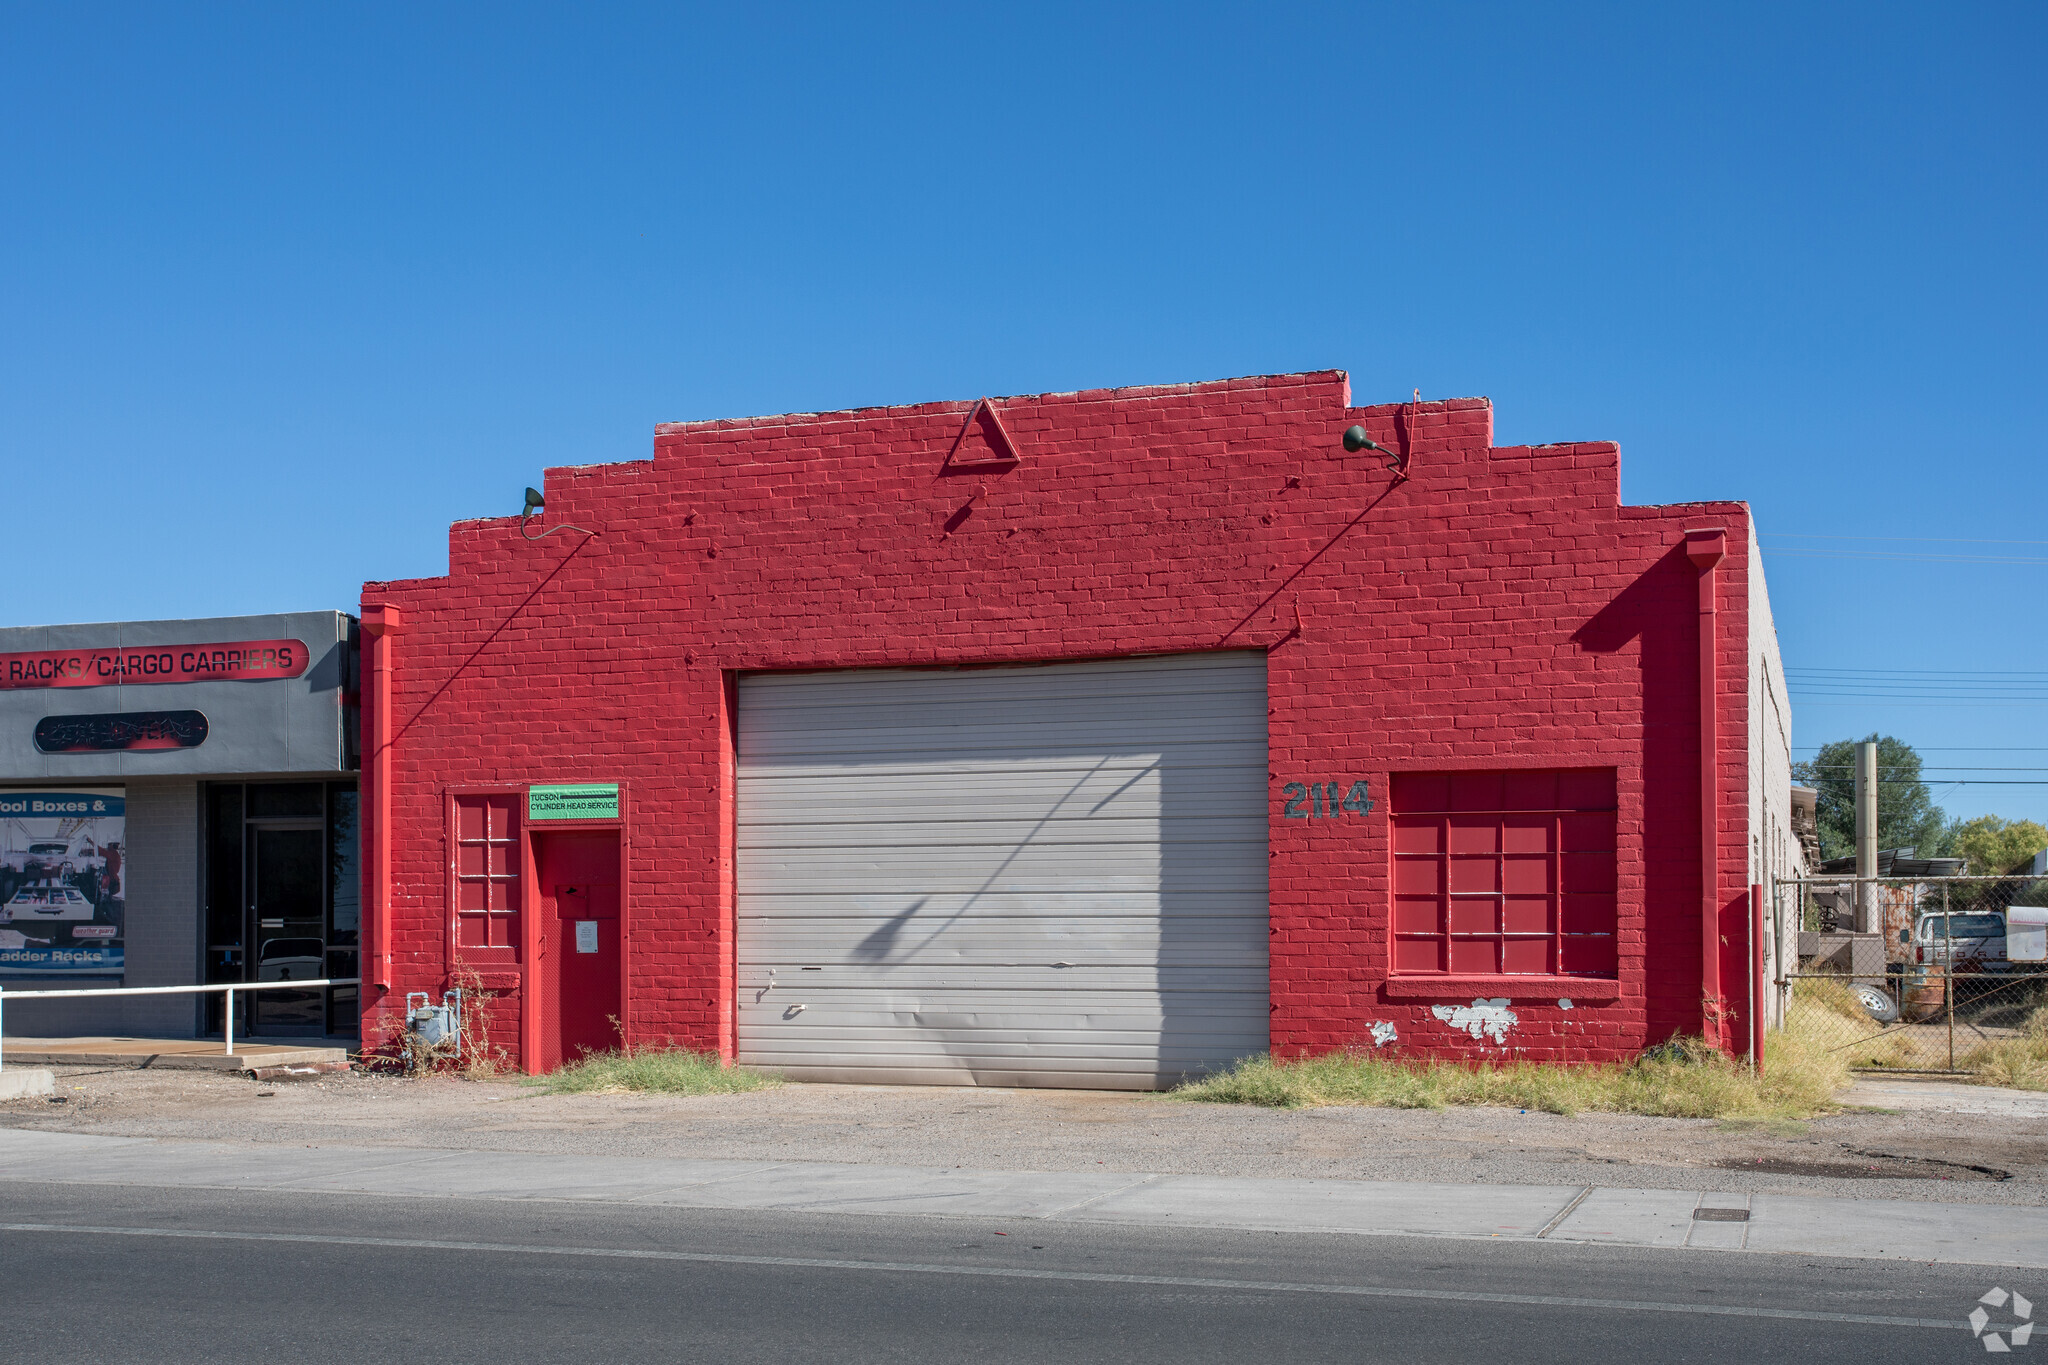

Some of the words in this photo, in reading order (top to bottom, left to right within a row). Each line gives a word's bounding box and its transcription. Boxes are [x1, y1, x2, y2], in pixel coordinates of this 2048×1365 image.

[180, 647, 293, 673] CARRIERS
[530, 794, 560, 802] TUCSON
[1282, 780, 1375, 819] 2114
[0, 800, 27, 812] ool
[32, 800, 88, 812] Boxes
[92, 799, 106, 812] &
[530, 802, 566, 811] CYLINDER
[566, 802, 587, 810] HEAD
[587, 801, 618, 809] SERVICE
[0, 950, 48, 962] adder
[52, 950, 103, 962] Racks
